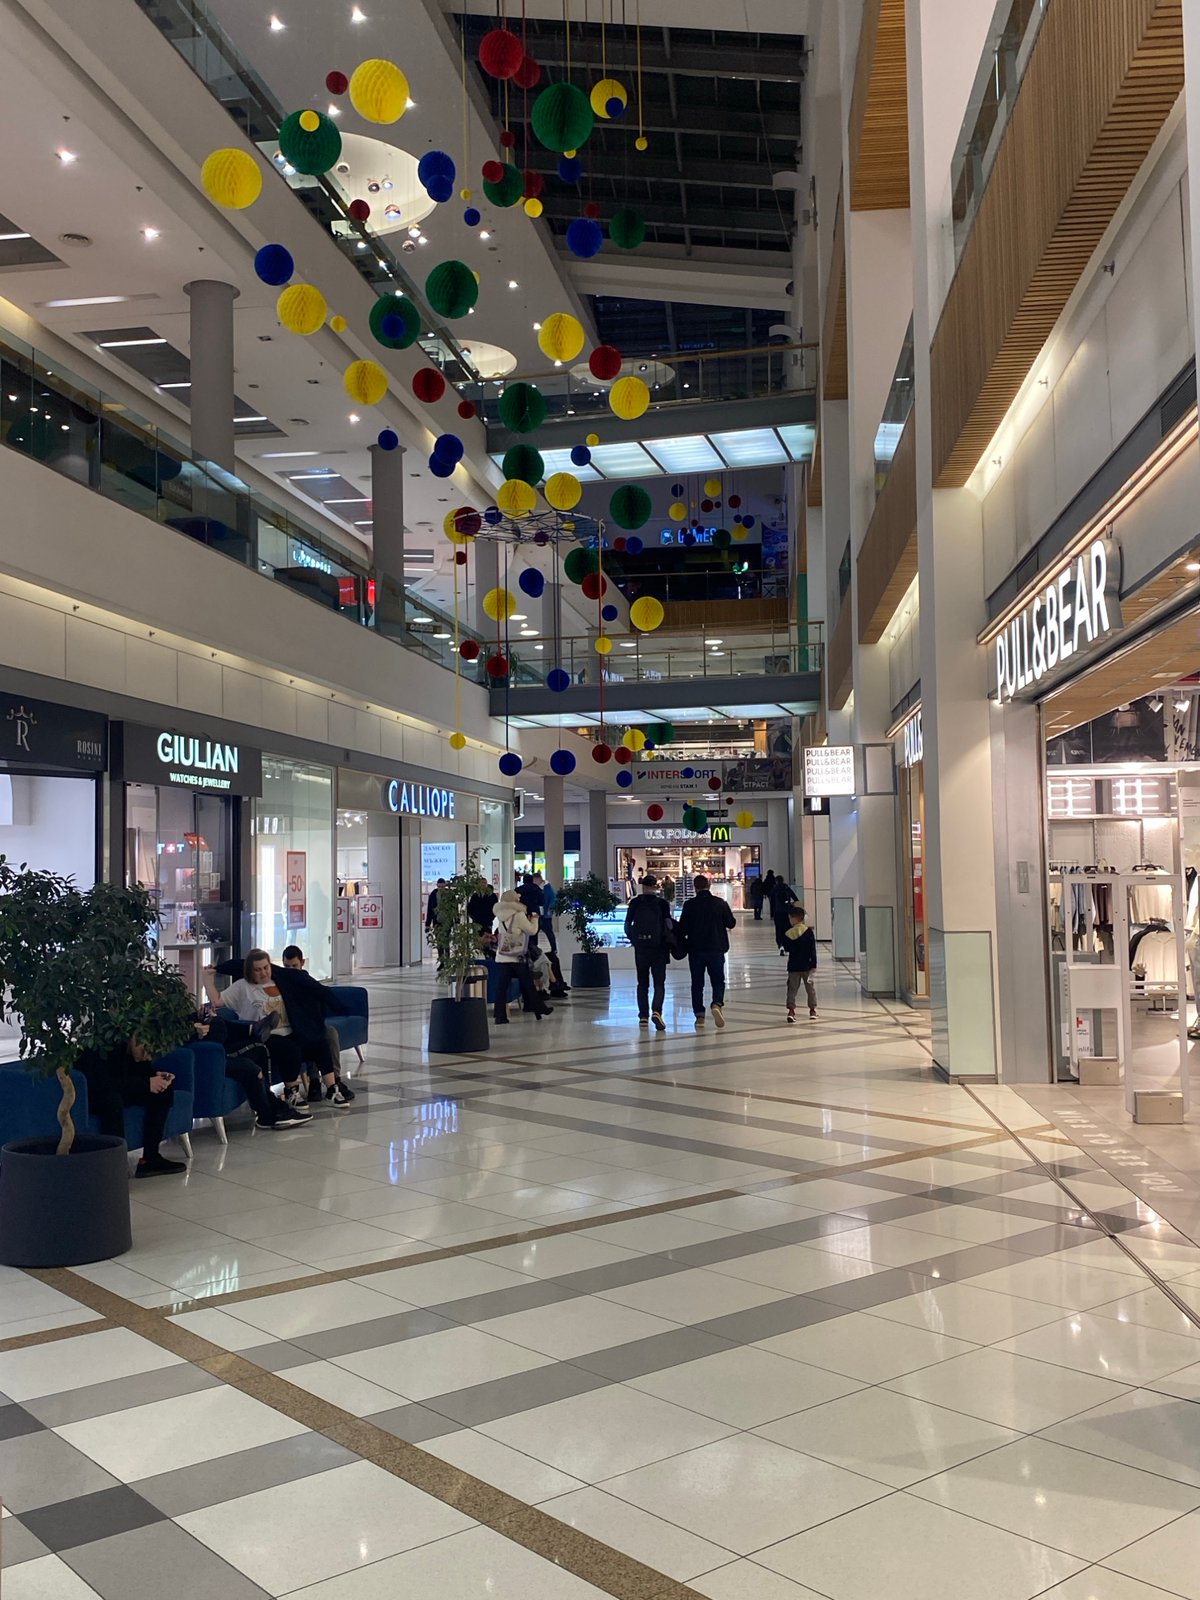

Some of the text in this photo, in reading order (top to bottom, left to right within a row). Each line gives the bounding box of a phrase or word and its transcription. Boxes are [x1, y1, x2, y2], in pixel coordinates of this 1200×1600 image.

[678, 528, 717, 544] GMES
[996, 540, 1110, 701] PULL&BEAR
[16, 720, 30, 751] R
[77, 740, 102, 756] ROSINI
[157, 732, 239, 773] GIULIAN
[806, 749, 851, 757] PULL&BEAR
[806, 758, 851, 766] PULL&BEAR
[169, 772, 231, 789] WATCHES & JEWELLERY
[648, 769, 716, 779] INTERSORT
[388, 780, 455, 819] CALLIOPE
[644, 828, 665, 839] U.S.
